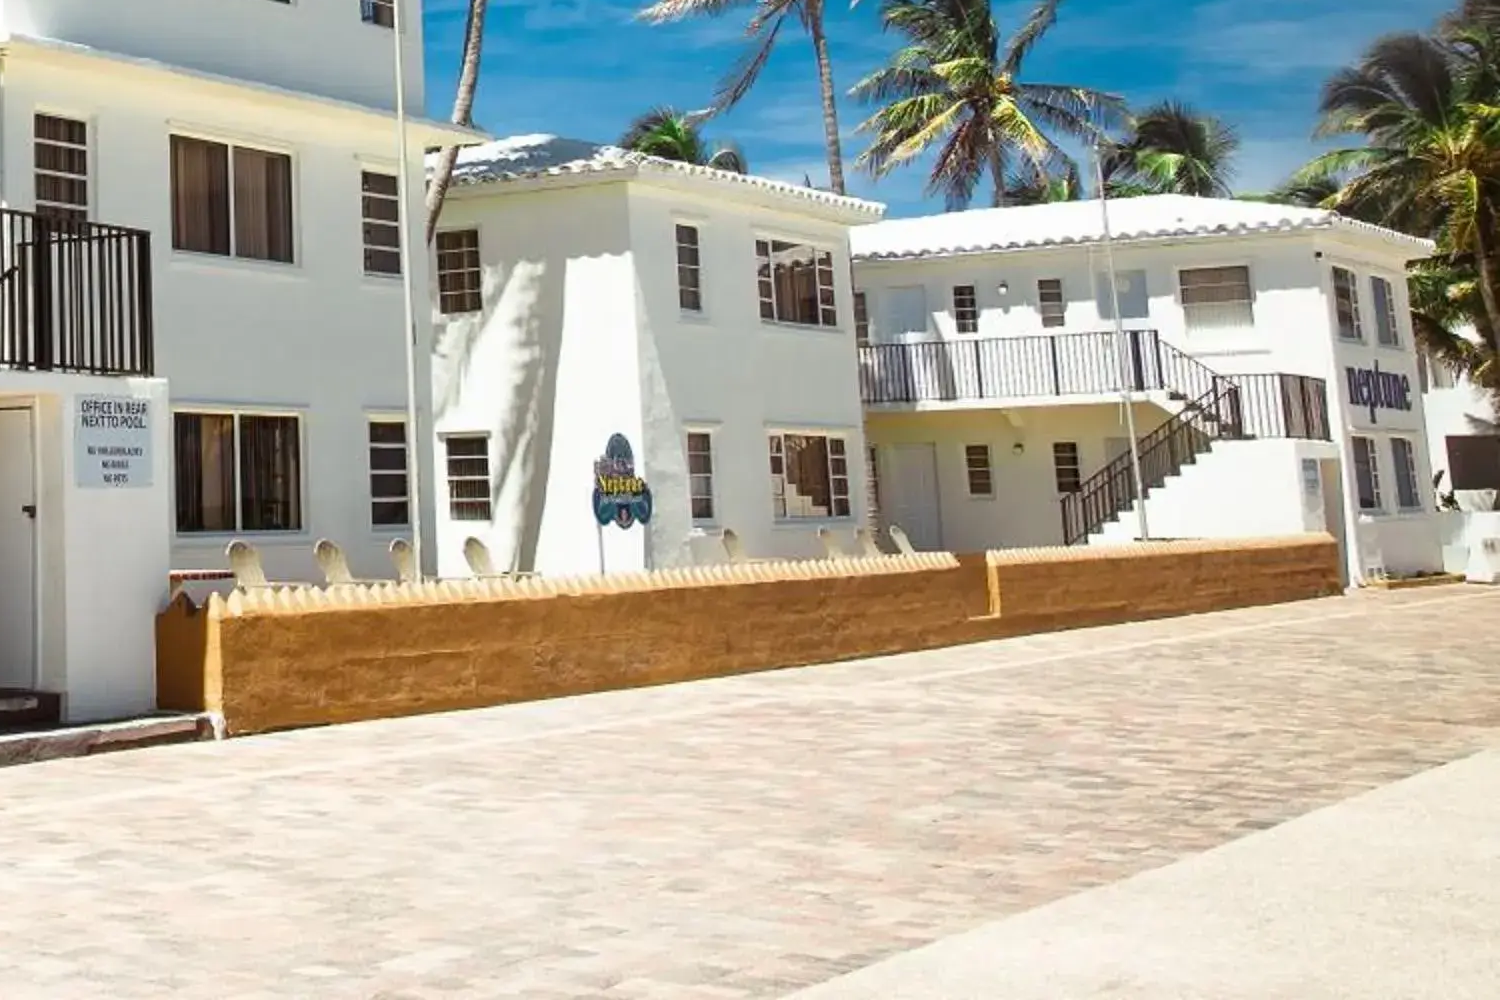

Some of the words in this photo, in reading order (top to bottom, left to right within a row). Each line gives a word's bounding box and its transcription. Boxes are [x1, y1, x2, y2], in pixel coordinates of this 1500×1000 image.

[1345, 359, 1412, 424] neptune
[81, 400, 112, 415] OFFICE
[113, 401, 123, 415] IN
[125, 402, 147, 416] REAR
[81, 415, 105, 428] NEXT
[105, 415, 118, 429] TO
[120, 416, 147, 429] POOL
